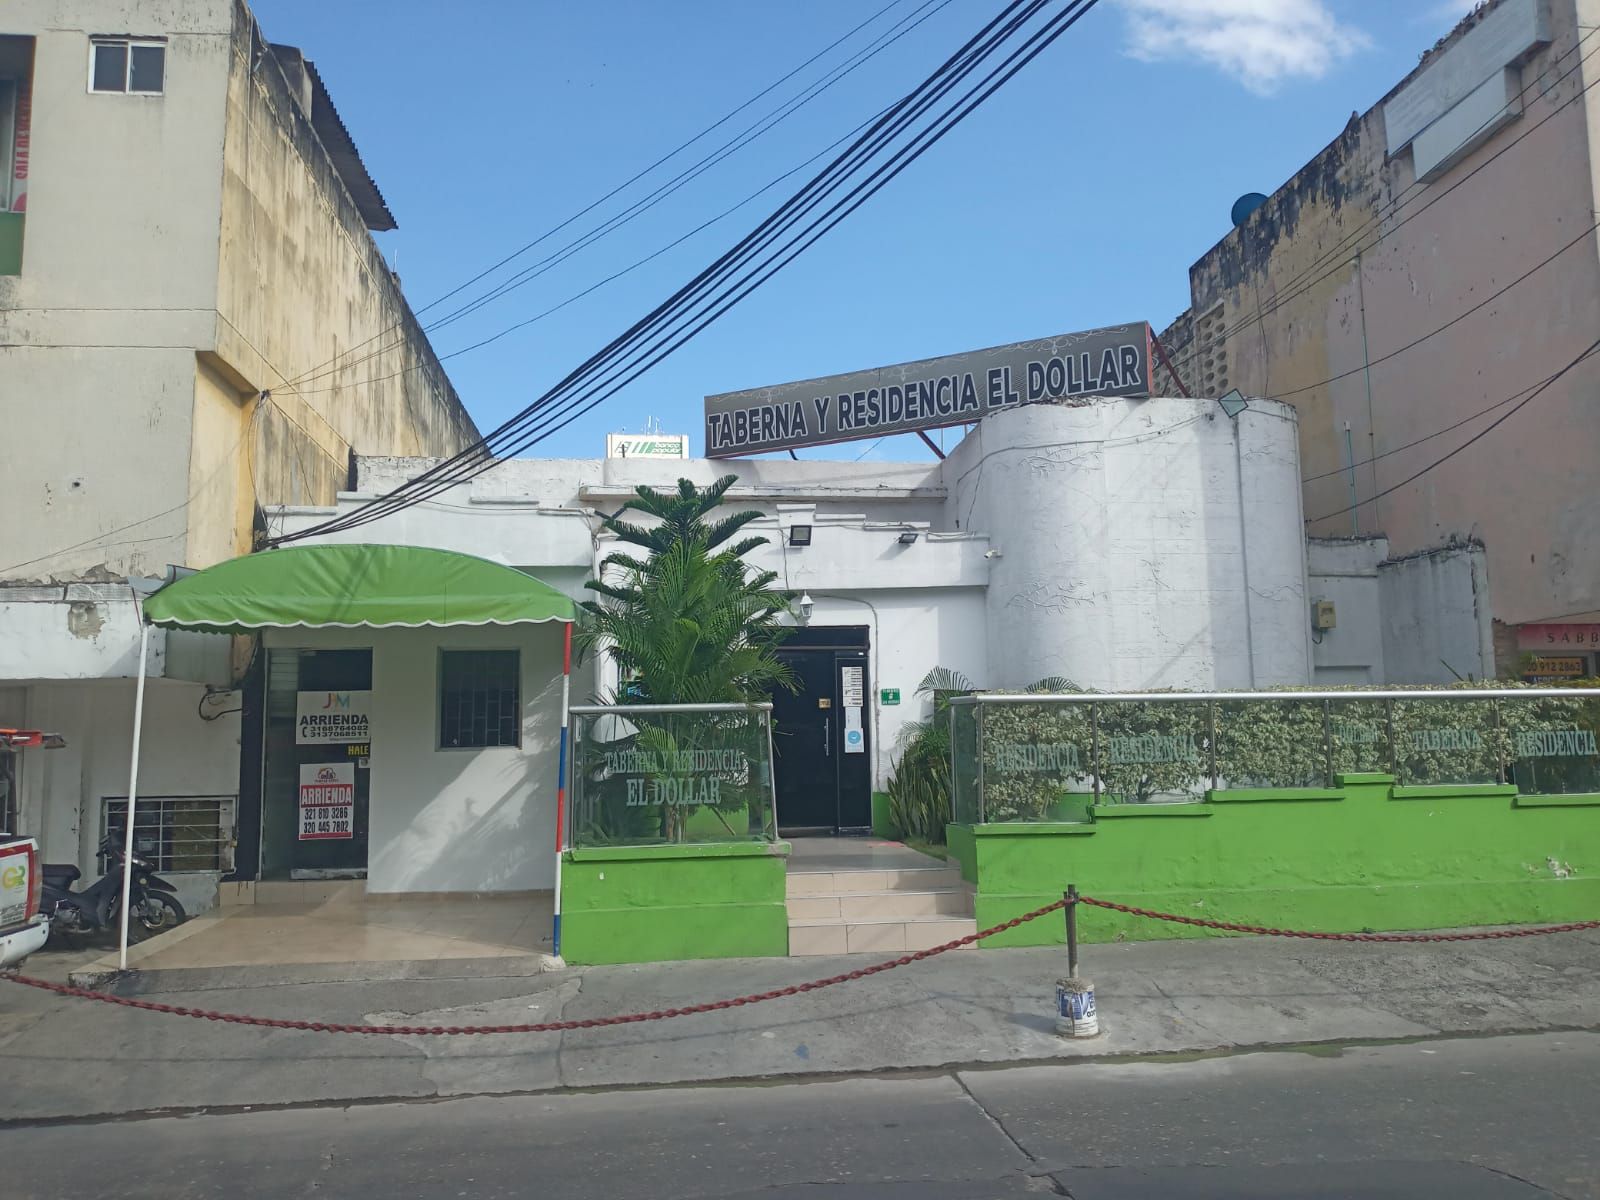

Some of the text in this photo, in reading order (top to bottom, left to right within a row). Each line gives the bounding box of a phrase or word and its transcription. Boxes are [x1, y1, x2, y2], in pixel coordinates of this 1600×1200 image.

[708, 344, 1140, 449] TABERNA Y RESIDENCIA EL DOLLAR
[300, 714, 368, 726] ARRIENDA
[1412, 728, 1482, 750] TABERNA
[1516, 730, 1599, 757] RESIDENCIA
[348, 745, 369, 755] HALE
[605, 749, 743, 774] TABERNA Y RESIDENCIA
[301, 787, 352, 805] ARRIENDA
[626, 776, 722, 807] EL DOLLAR
[304, 808, 316, 820] 321
[303, 822, 316, 834] 320
[318, 821, 330, 833] 445
